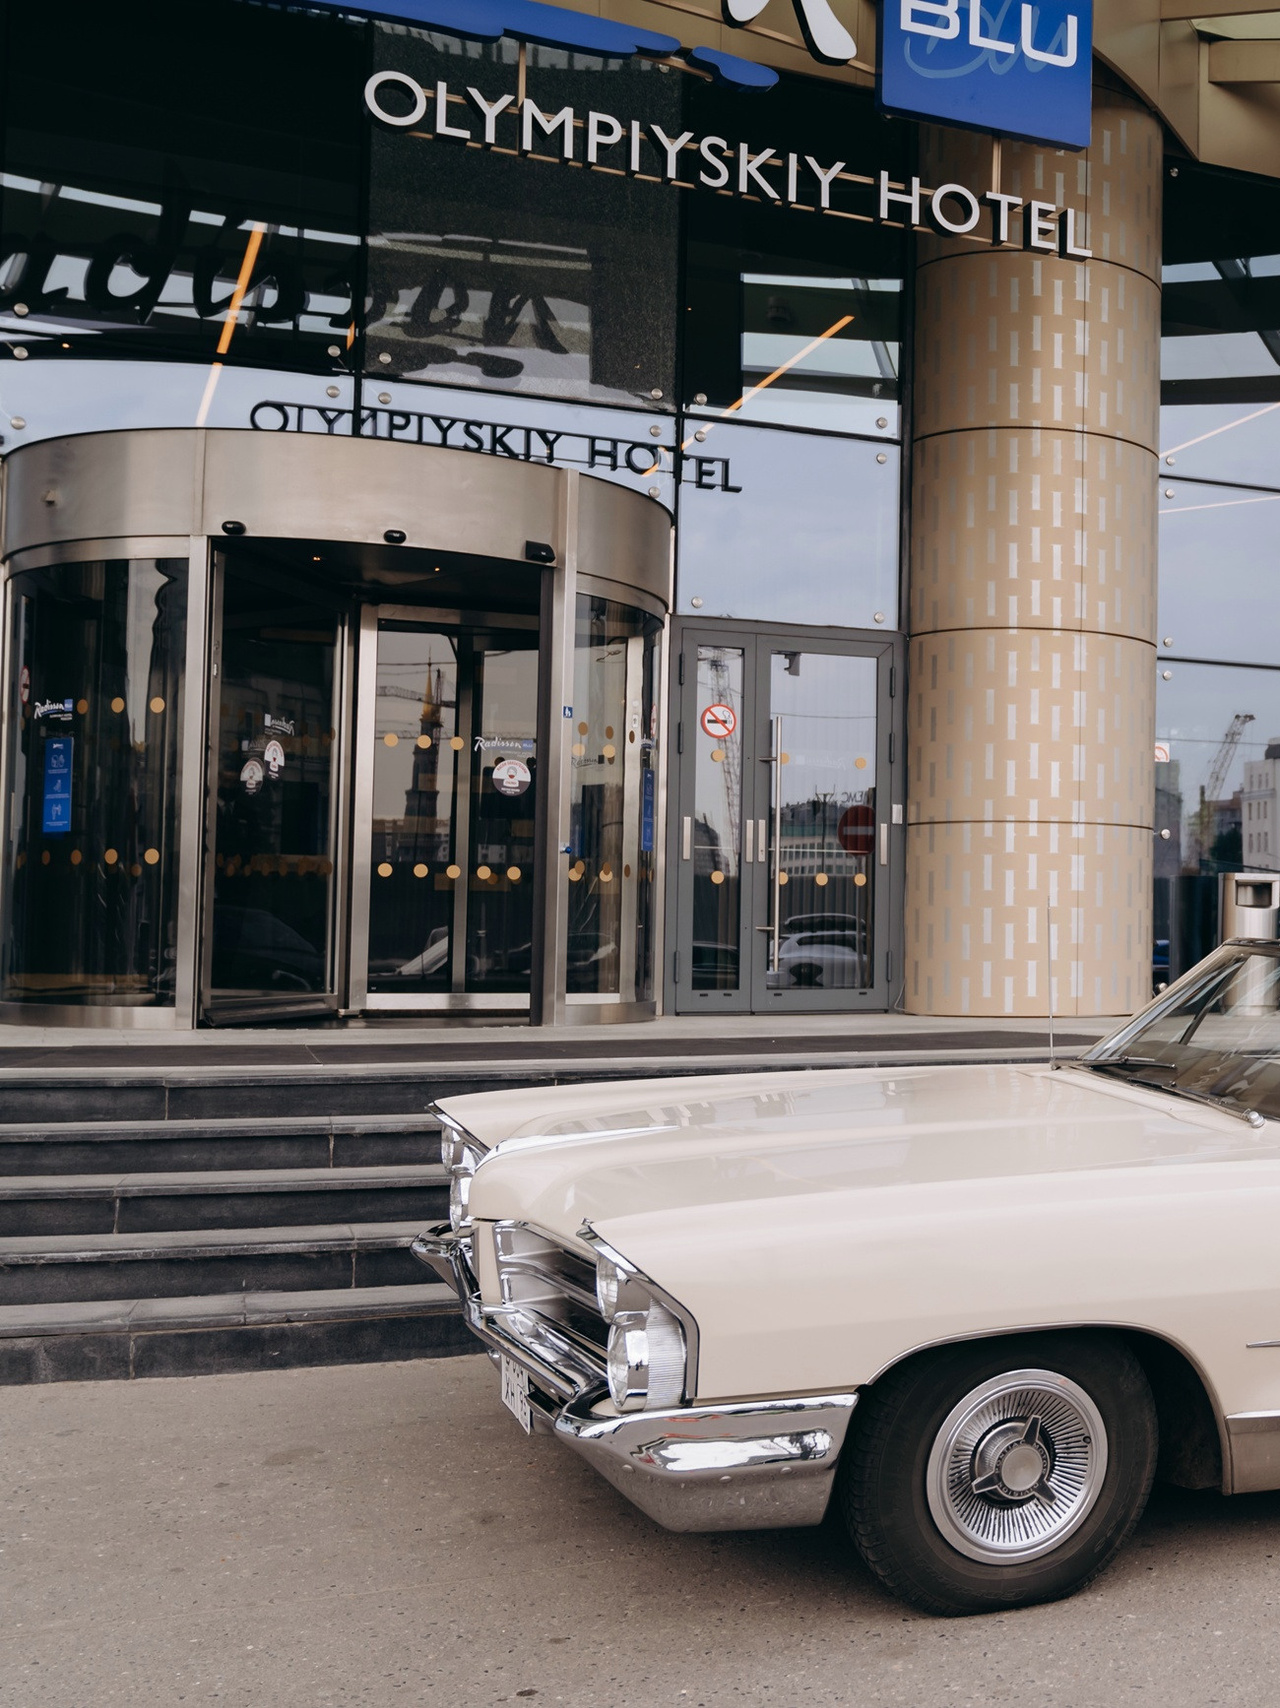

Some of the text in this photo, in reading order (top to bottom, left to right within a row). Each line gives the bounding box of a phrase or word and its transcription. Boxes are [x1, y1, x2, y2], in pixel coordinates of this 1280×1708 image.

[901, 0, 1078, 67] BLU
[364, 70, 1091, 259] OLYMPIYSKIY HOTEL
[474, 736, 522, 751] Radisson
[995, 1439, 1048, 1497] PONTIAC MOTOR DIVISION
